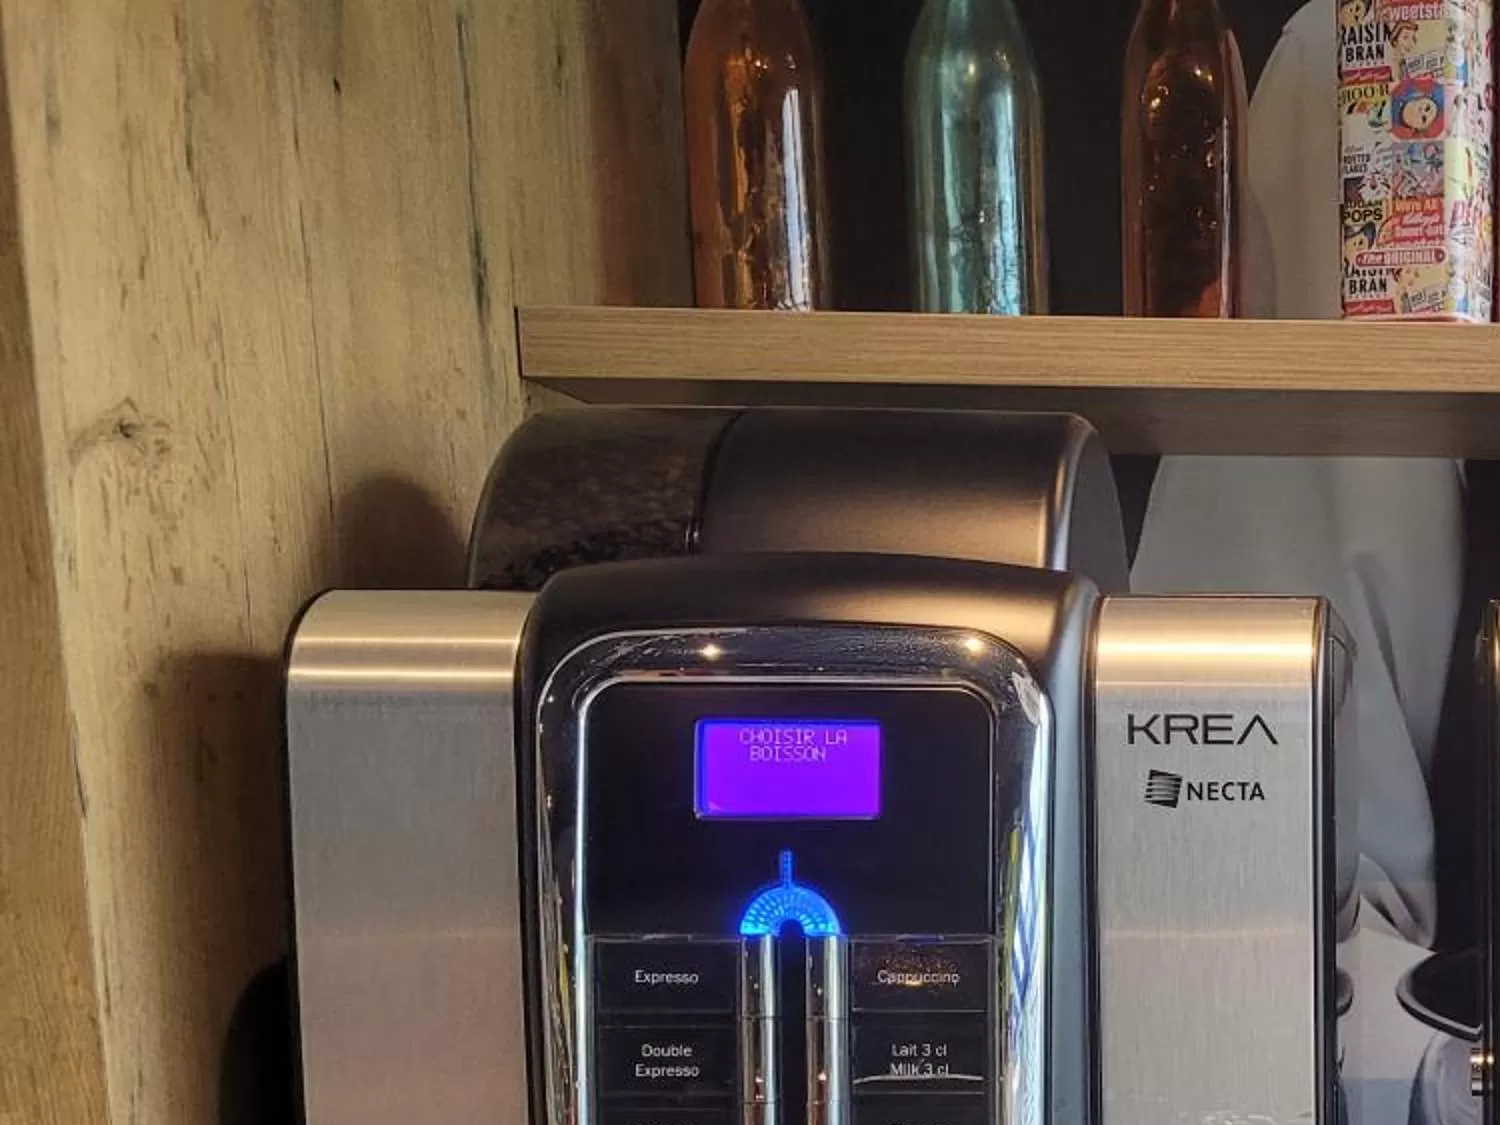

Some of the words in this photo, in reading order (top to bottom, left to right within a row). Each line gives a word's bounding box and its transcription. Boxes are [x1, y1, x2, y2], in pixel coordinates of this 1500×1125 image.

[1345, 44, 1384, 62] BRAN
[1349, 278, 1388, 294] BRAN
[739, 728, 815, 745] CHOISIR
[825, 729, 848, 745] LA
[1127, 713, 1279, 745] KREA
[750, 746, 827, 762] BOISSON
[1187, 781, 1265, 801] NECTA
[635, 971, 699, 985] Expresso
[642, 1044, 692, 1057] Double
[892, 1044, 918, 1056] Lait
[635, 1064, 699, 1078] Expresso
[891, 1063, 918, 1076] Milk
